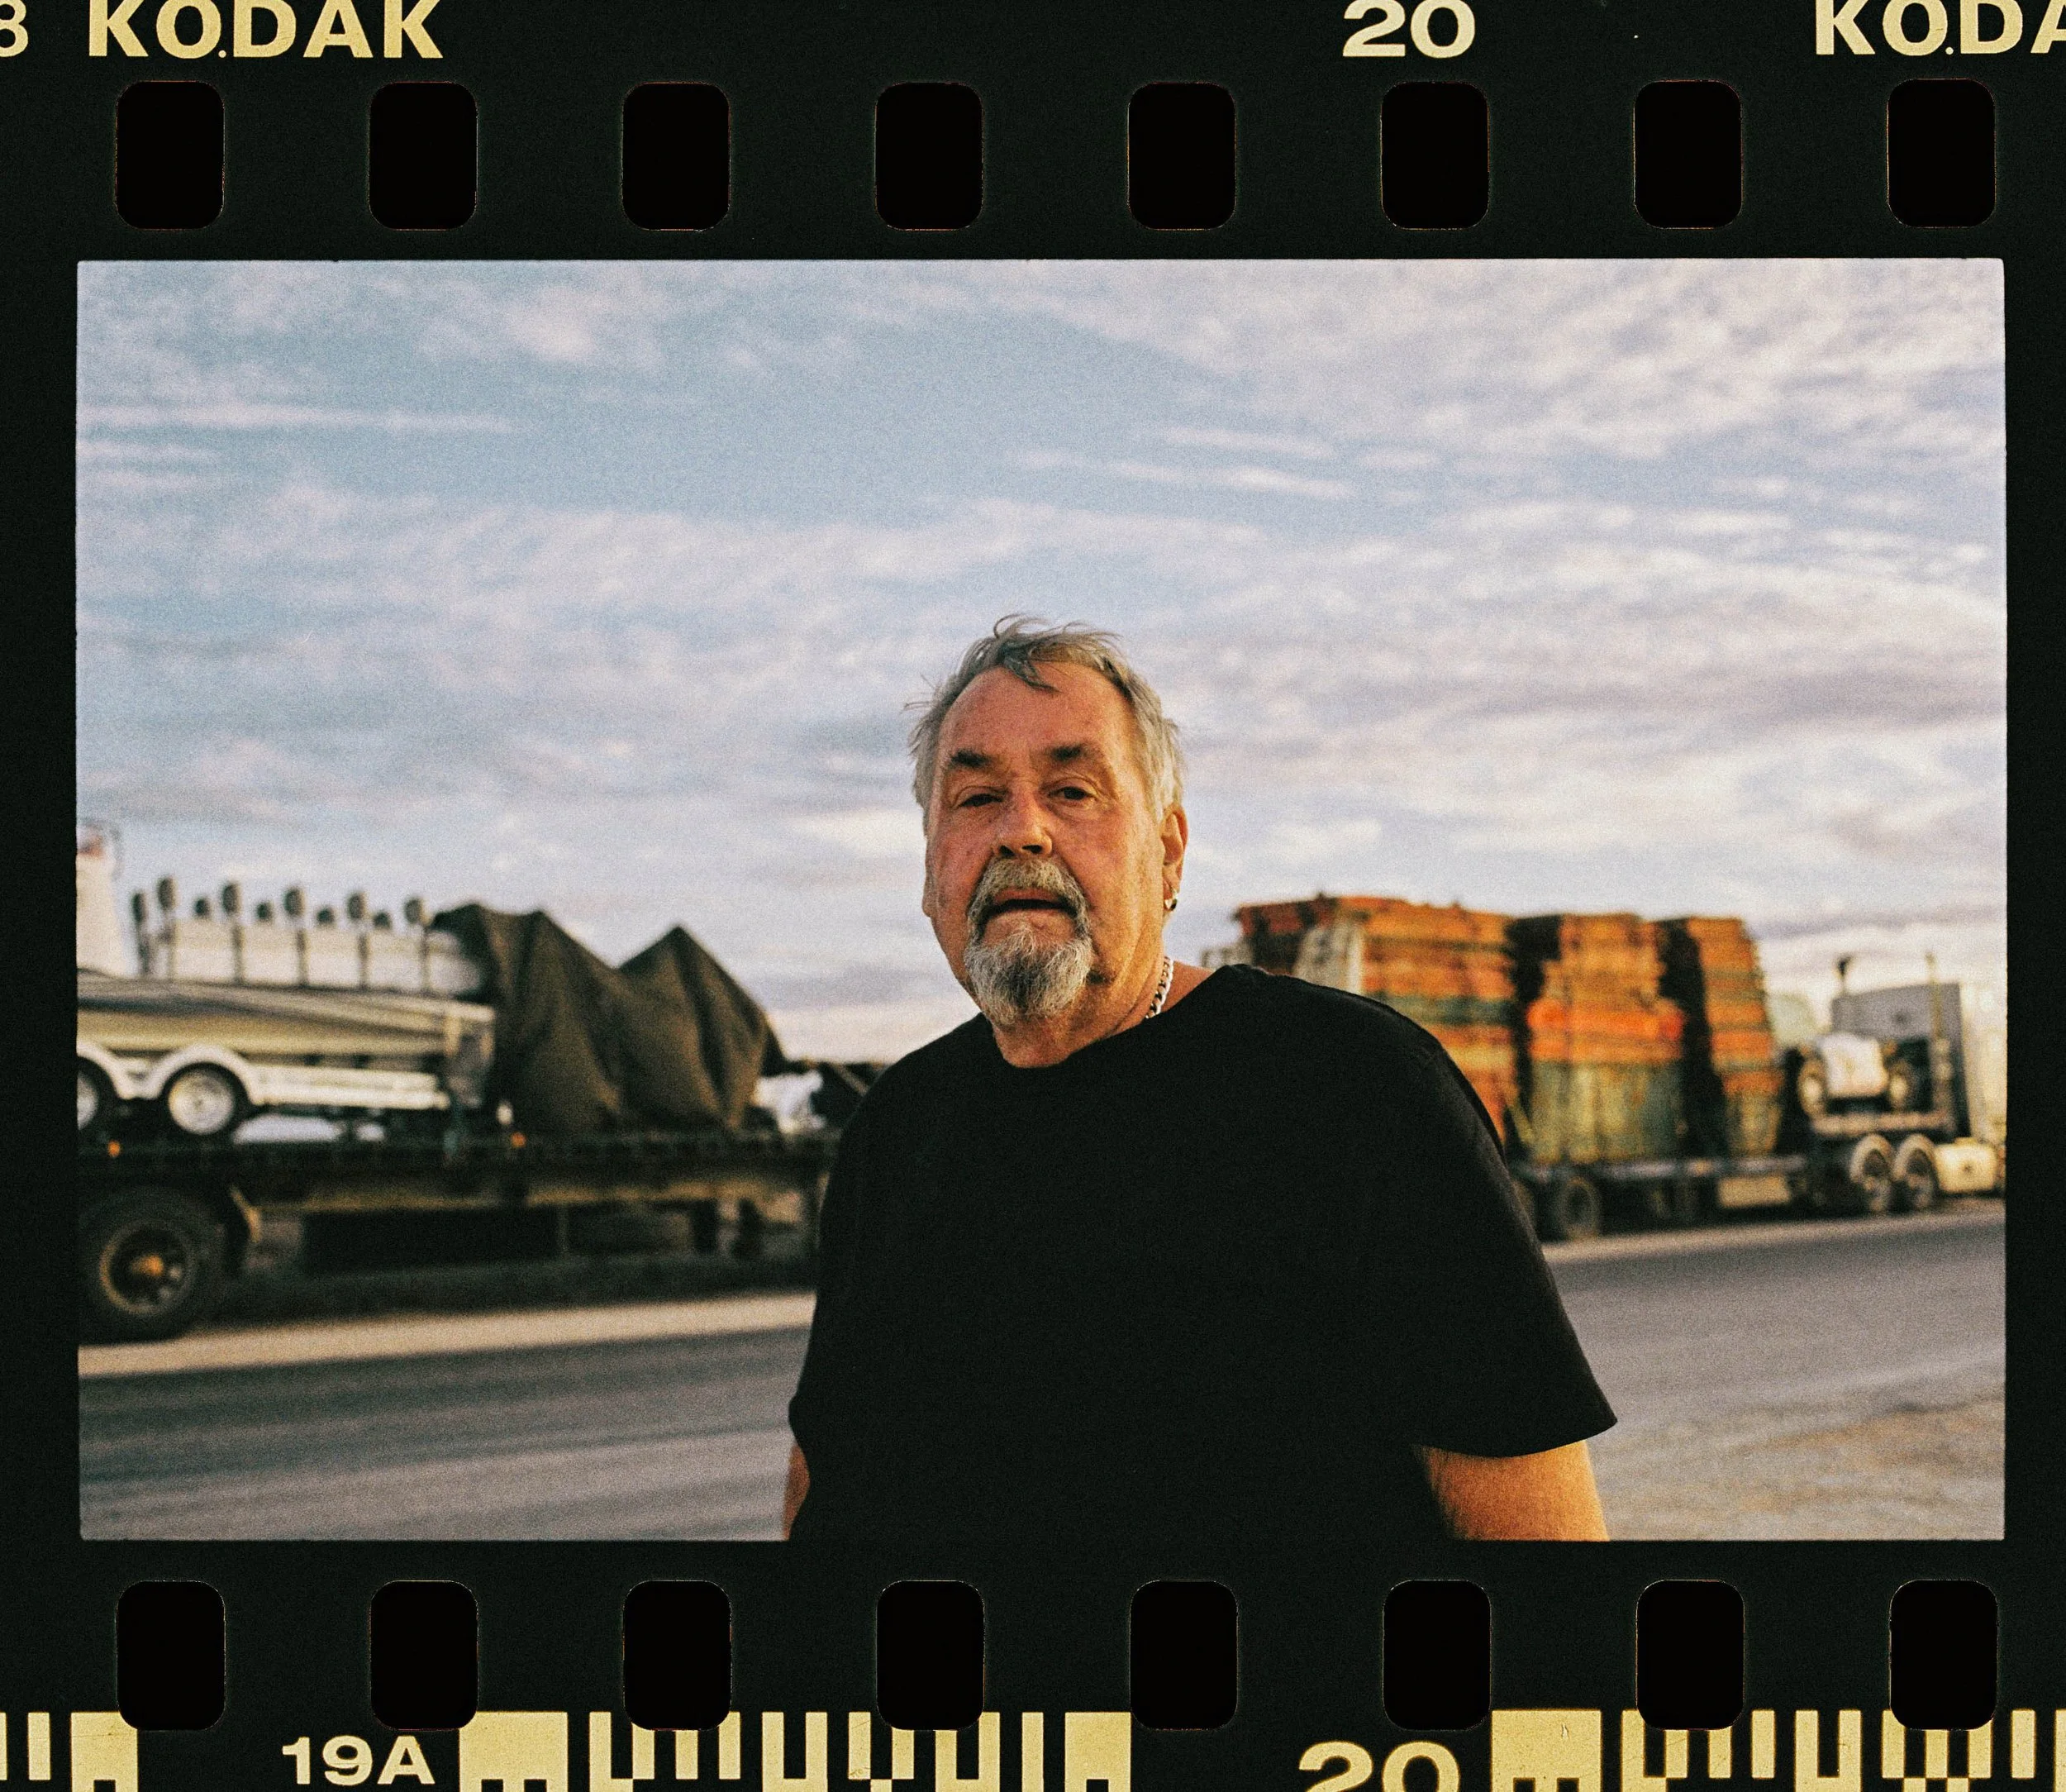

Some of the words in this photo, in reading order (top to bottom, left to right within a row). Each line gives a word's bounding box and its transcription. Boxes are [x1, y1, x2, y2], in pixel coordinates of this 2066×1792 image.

[1342, 0, 1476, 59] 20
[282, 1735, 436, 1786] 19A
[1298, 1741, 1460, 1792] 20
